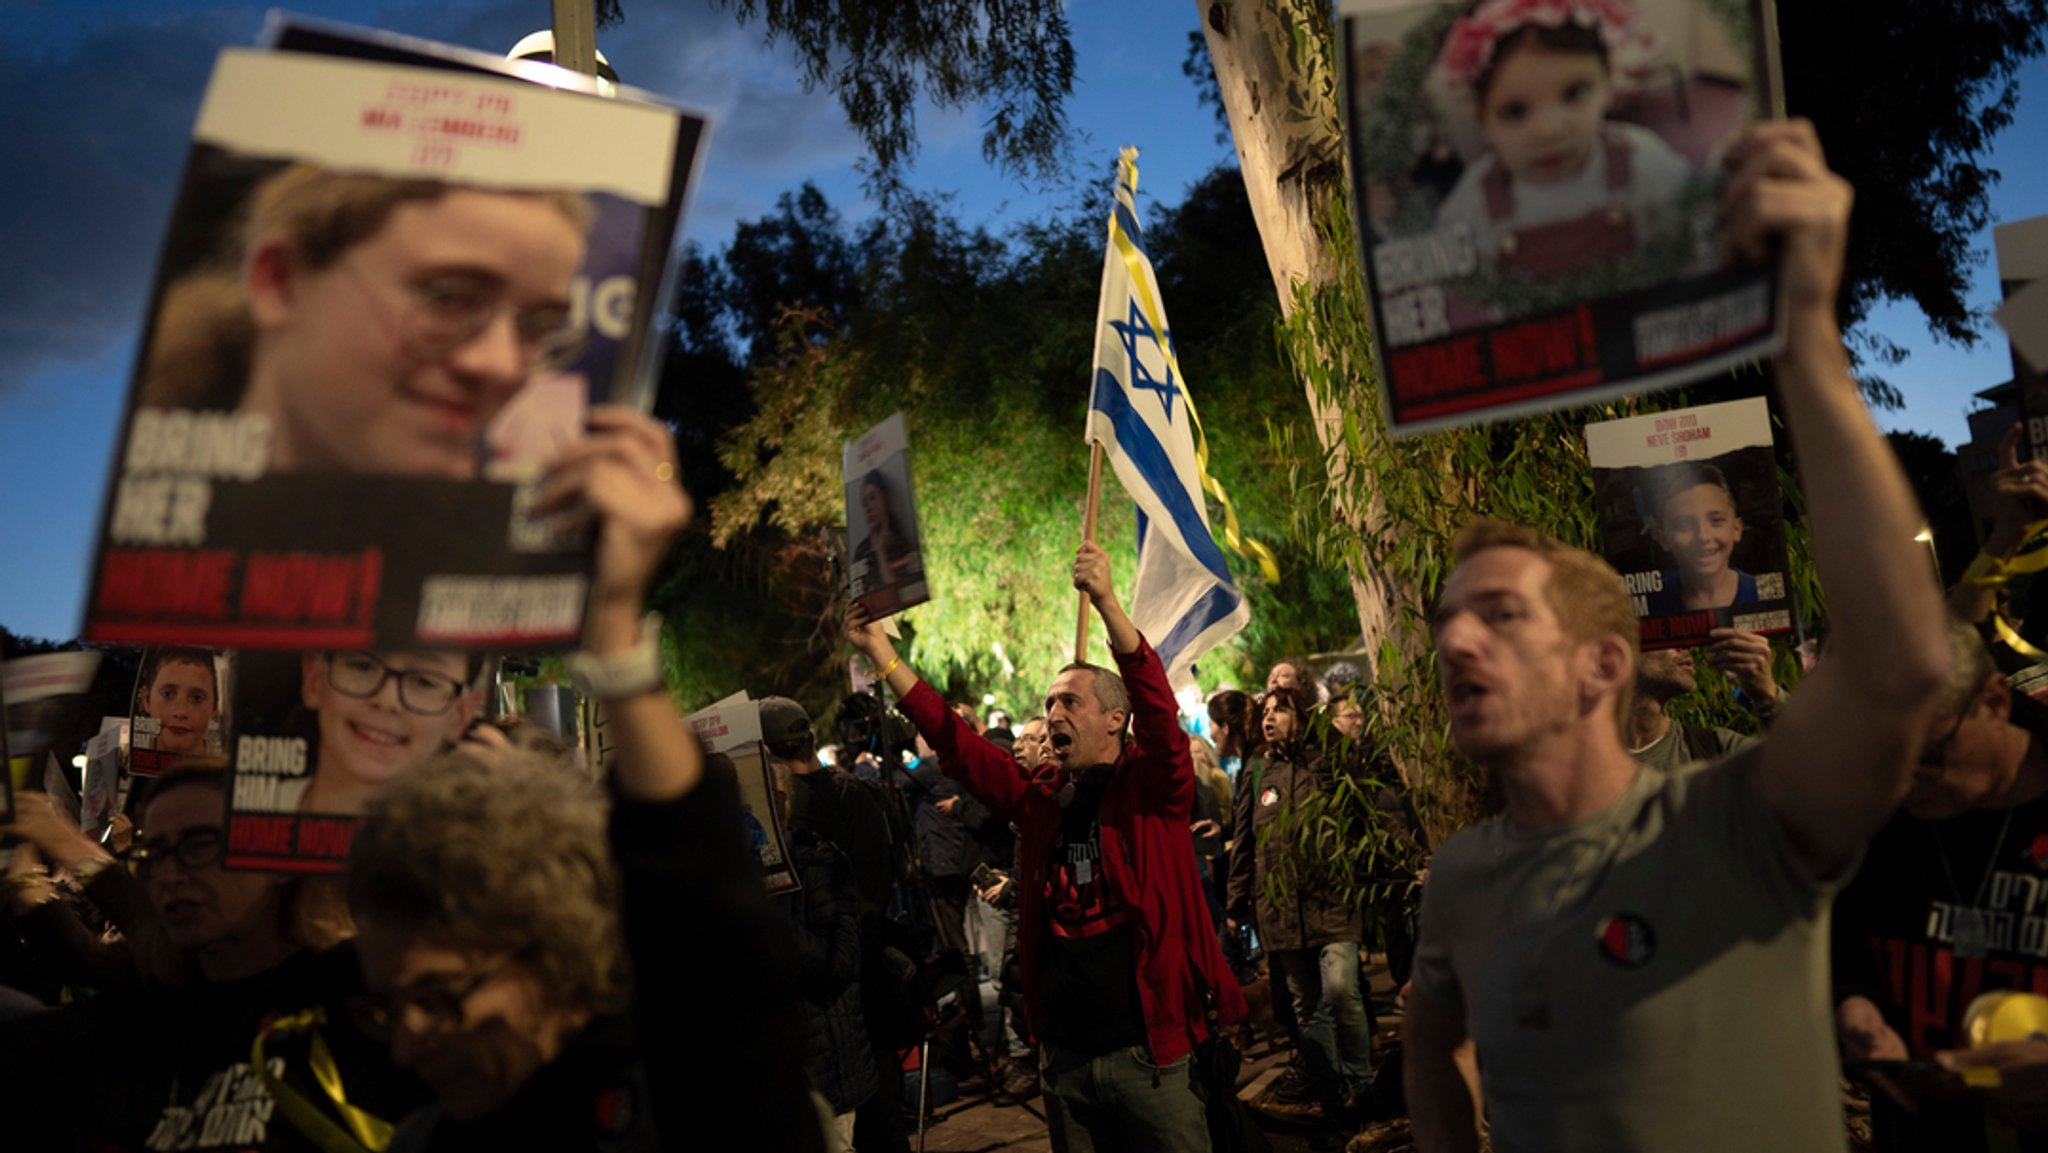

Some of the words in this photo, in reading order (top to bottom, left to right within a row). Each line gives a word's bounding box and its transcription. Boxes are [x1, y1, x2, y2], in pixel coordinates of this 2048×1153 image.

[1380, 286, 1451, 347] HER
[125, 406, 272, 483] BRING
[1672, 426, 1711, 445] SHOHAM
[111, 476, 213, 546] HER
[1669, 608, 1716, 639] NOW!
[236, 733, 308, 777] BRING
[232, 773, 280, 813] HIM
[228, 815, 297, 855] HOME
